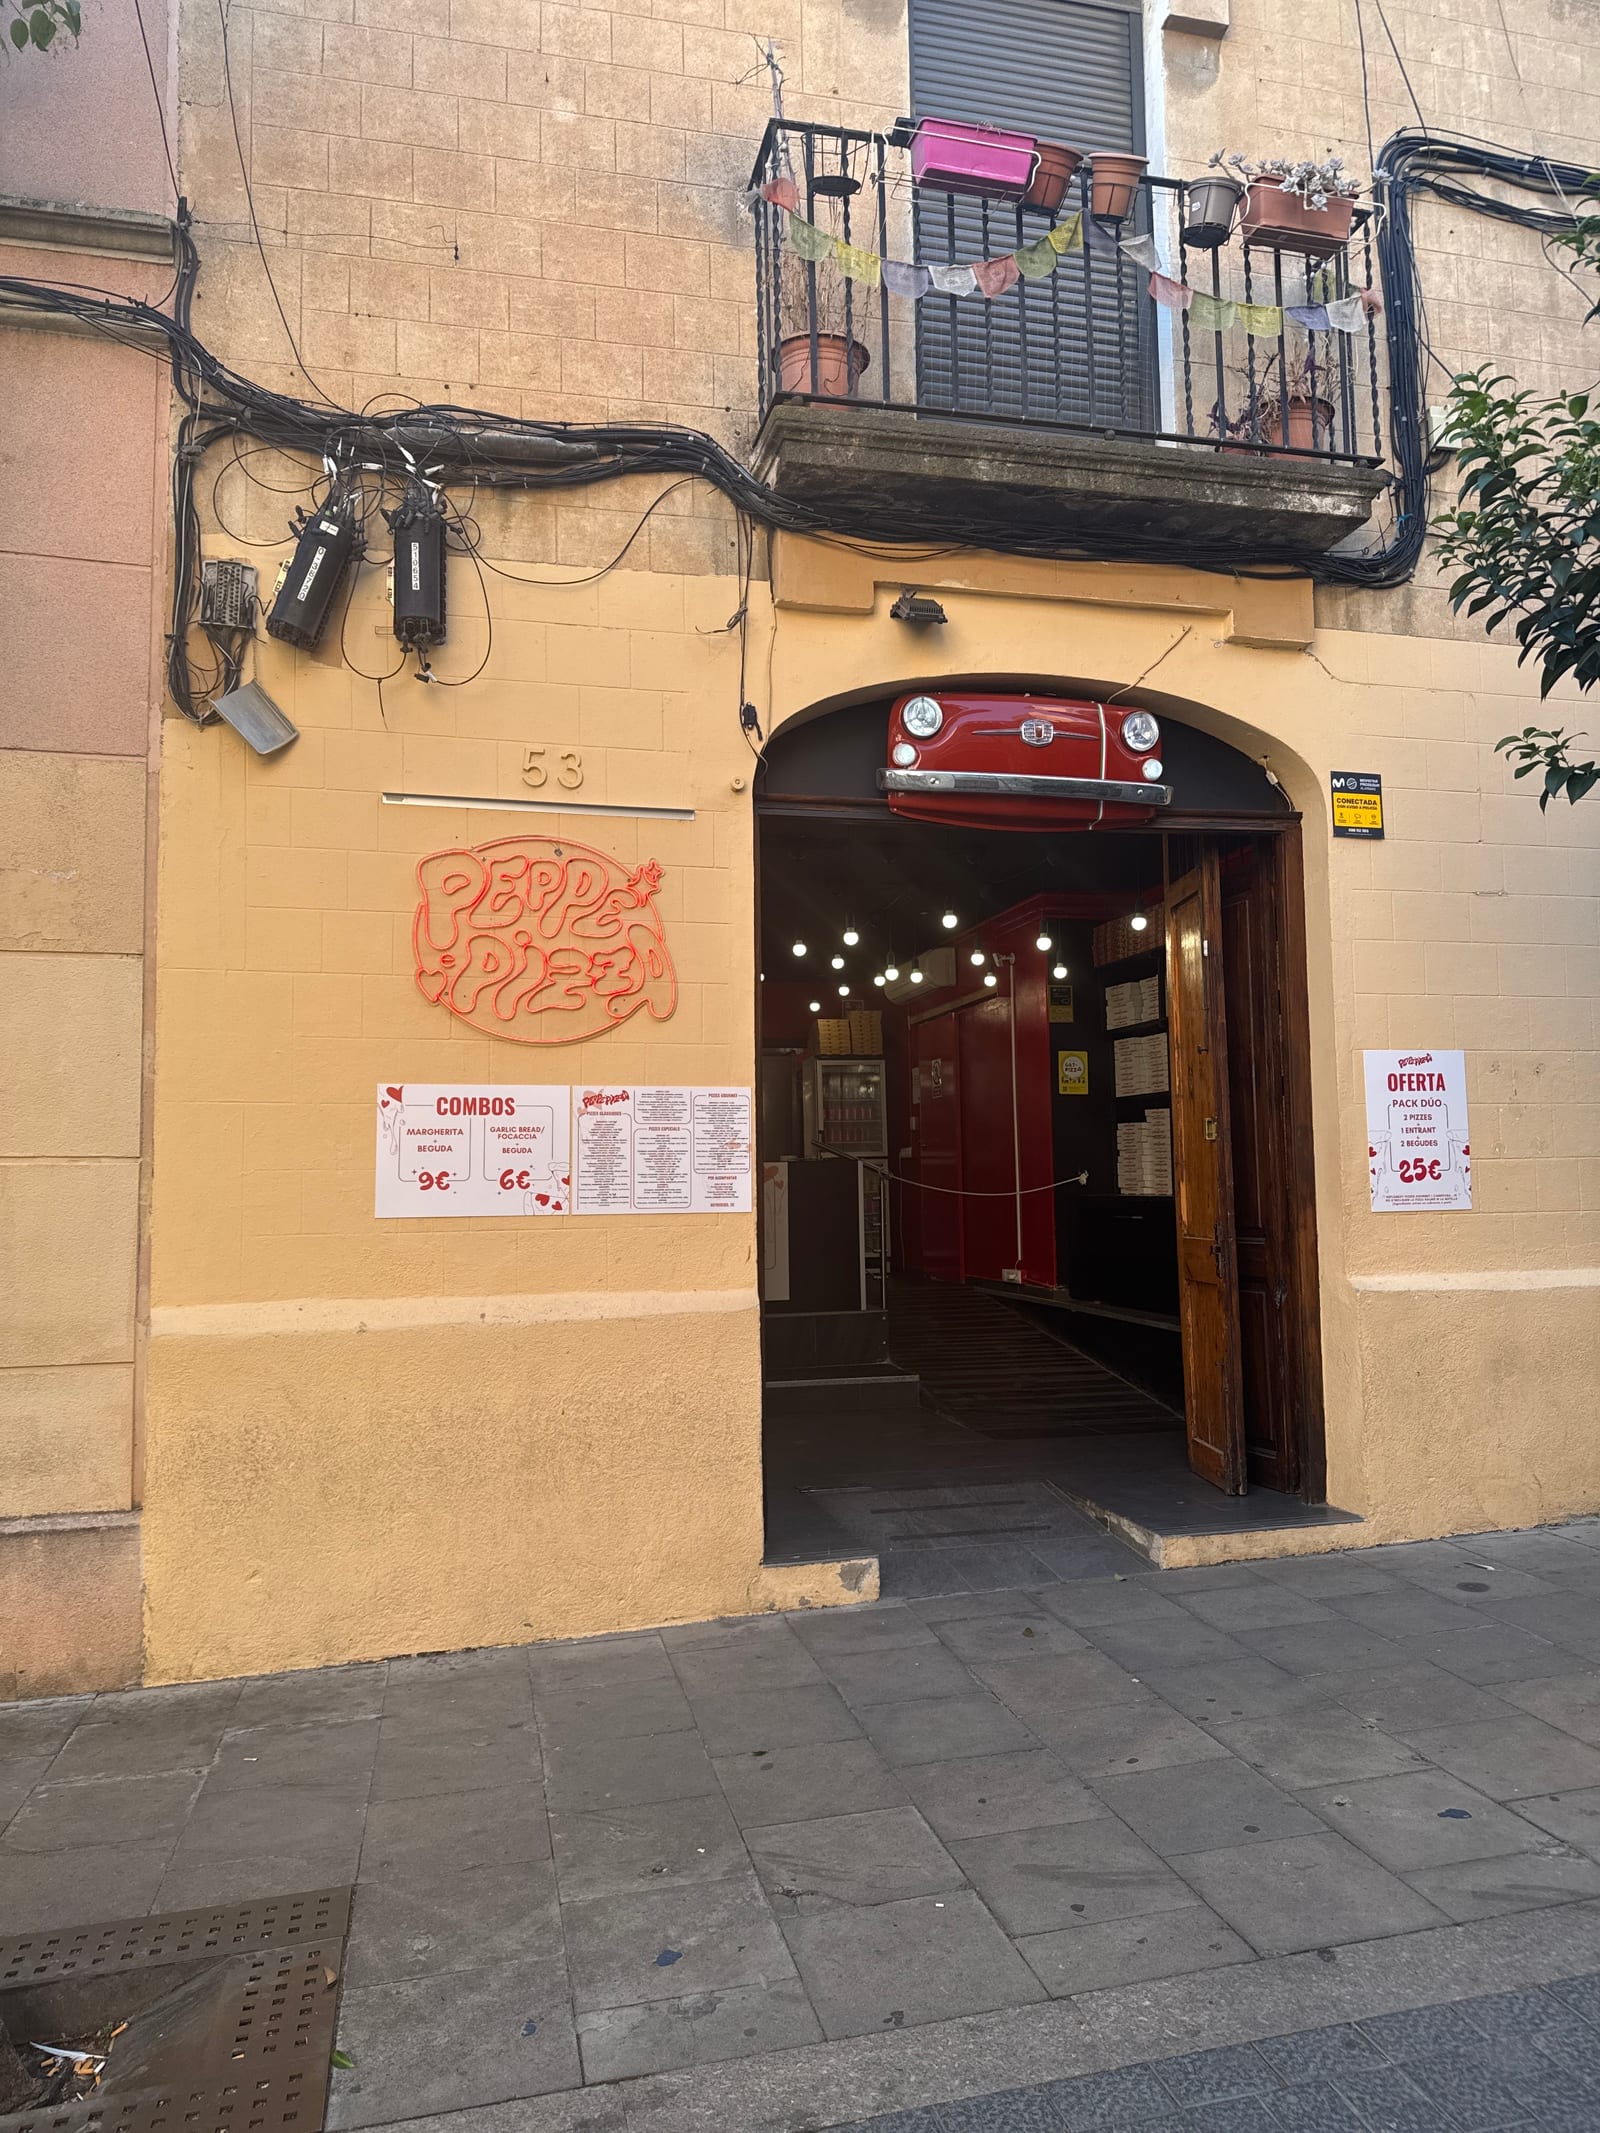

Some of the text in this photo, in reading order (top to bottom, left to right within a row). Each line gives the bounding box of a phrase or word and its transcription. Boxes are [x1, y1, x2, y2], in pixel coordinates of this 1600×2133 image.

[521, 748, 583, 789] 53
[1336, 797, 1378, 806] CONECTADA
[1387, 1073, 1446, 1092] OFERTA
[436, 1096, 516, 1116] COMBOS
[1392, 1097, 1442, 1108] PACK DÚO
[406, 1128, 464, 1136] MARGHERITA
[518, 1126, 546, 1134] BREAD/
[417, 1145, 453, 1153] BEGUDA
[1406, 1139, 1438, 1147] BEGUDES
[1399, 1157, 1442, 1184] 25€
[418, 1171, 450, 1191] 9€
[499, 1169, 531, 1190] 6€
